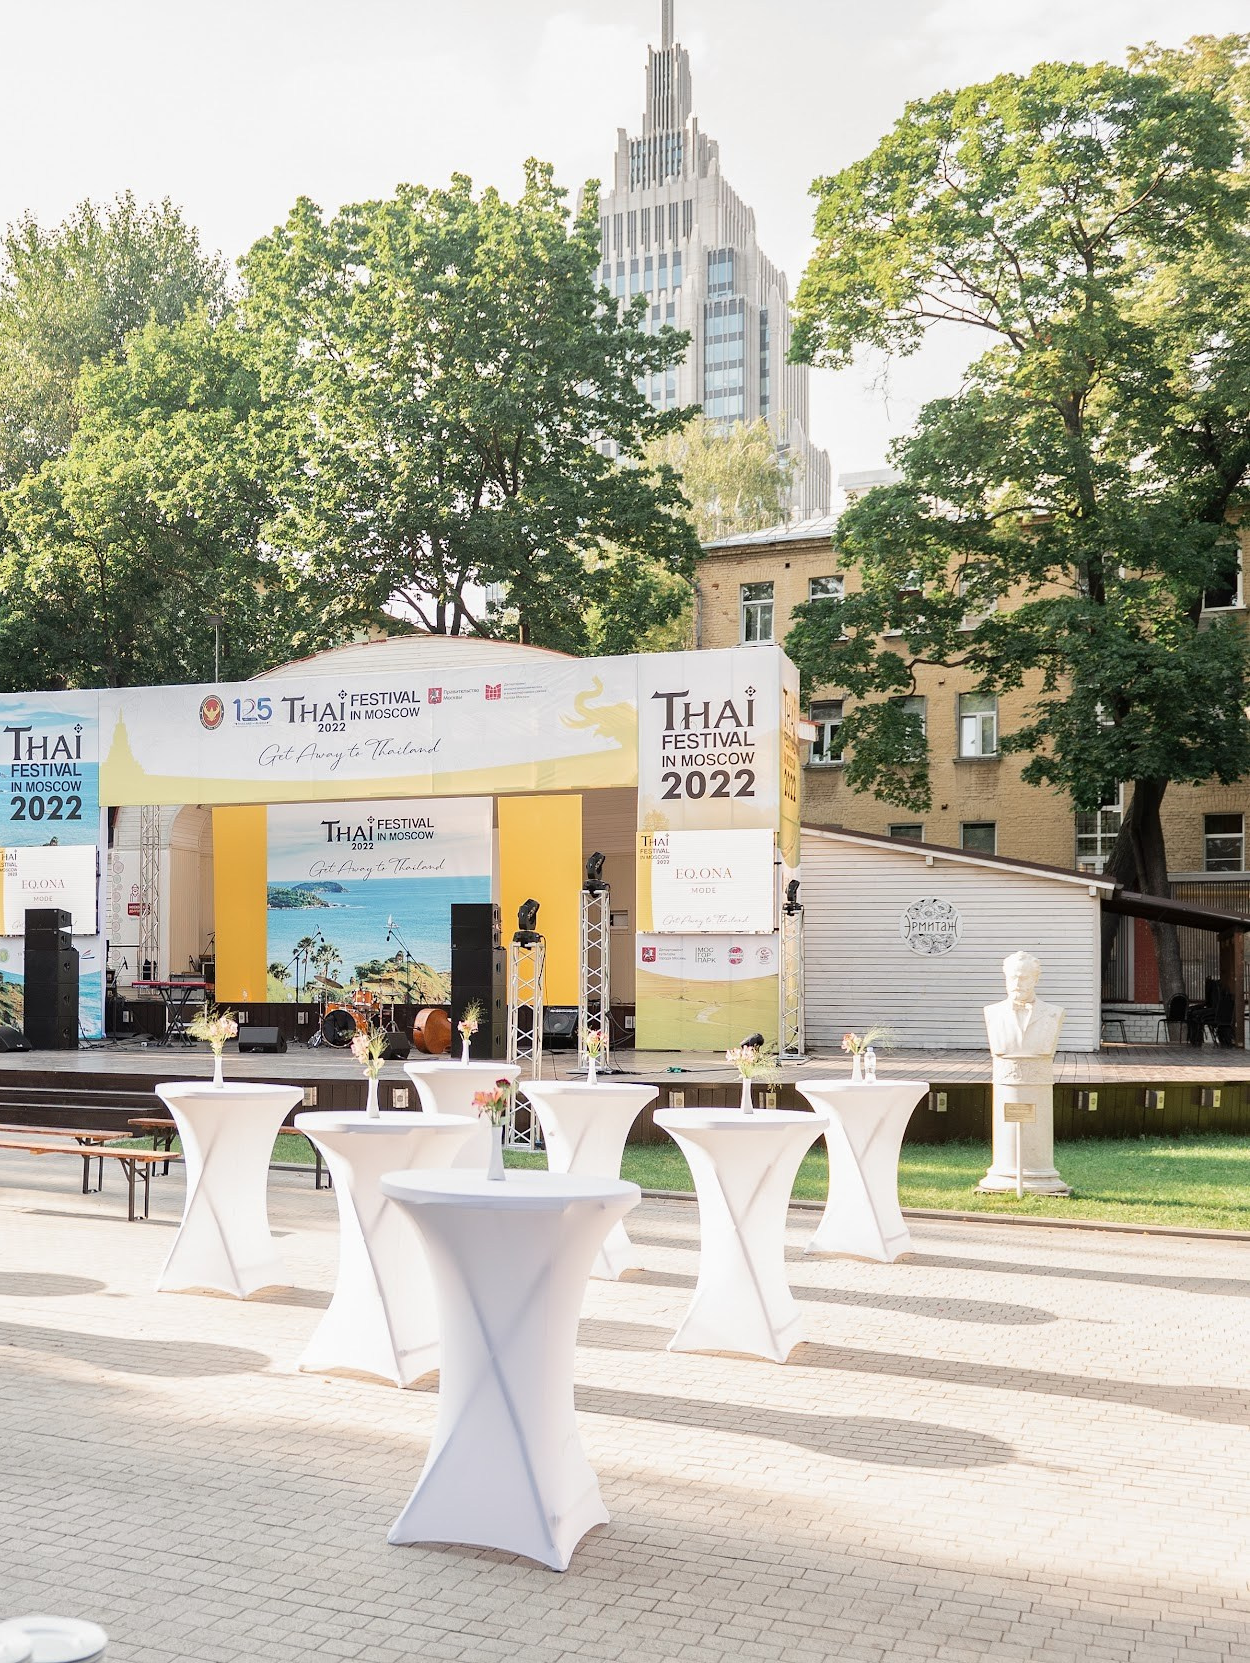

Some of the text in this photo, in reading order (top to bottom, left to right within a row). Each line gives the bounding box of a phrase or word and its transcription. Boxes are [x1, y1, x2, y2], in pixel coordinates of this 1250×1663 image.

[350, 690, 420, 707] FESTIVAL
[350, 708, 420, 720] IN MOSCOW
[318, 722, 346, 732] 2022
[662, 731, 755, 750] FESTIVAL
[258, 738, 442, 771] Get Away to Thailand
[662, 752, 755, 768] IN MOSCOW
[11, 763, 82, 778] FESTIVAL
[11, 780, 82, 793] IN MOSCOW
[661, 769, 755, 800] 2022
[10, 796, 82, 821] 2022
[378, 818, 434, 830] FESTIVAL
[390, 832, 434, 840] MOSCOW
[352, 842, 374, 850] 2022
[309, 858, 446, 881] Get Away to Thailand
[676, 867, 732, 880] EQ.ONA
[22, 879, 65, 890] EQ.ONA
